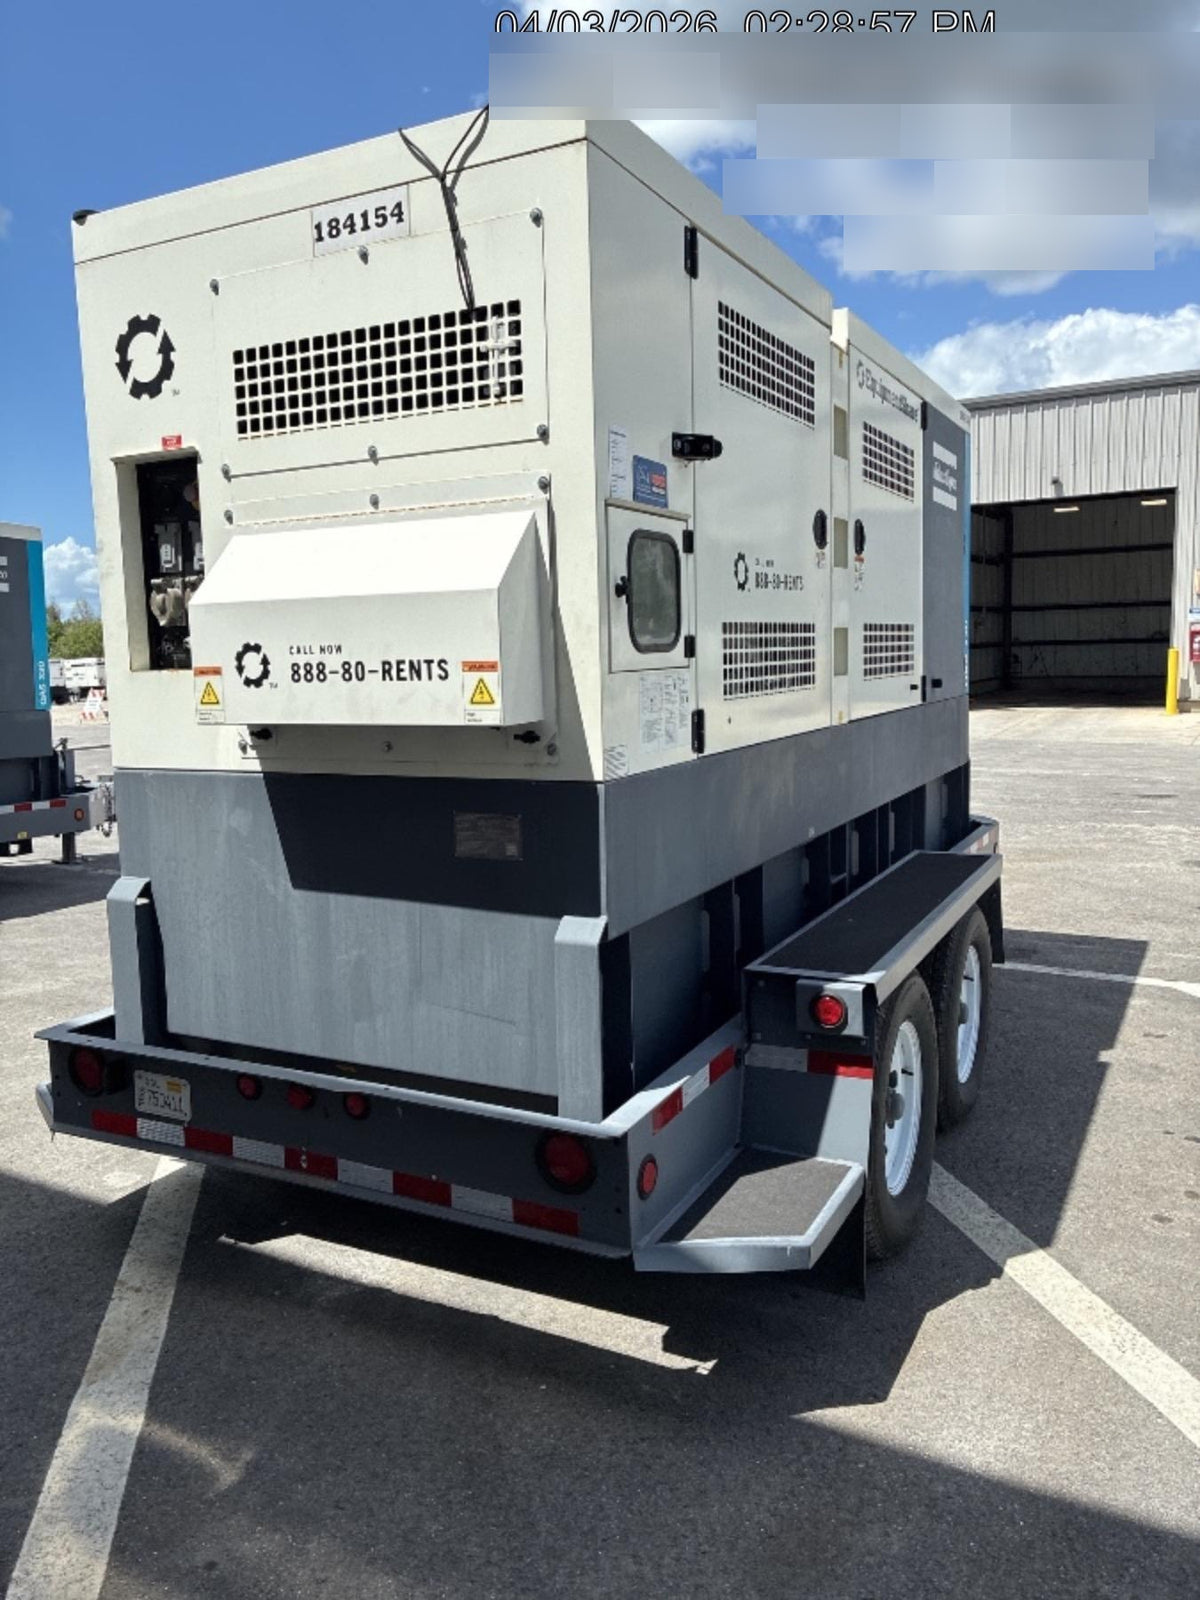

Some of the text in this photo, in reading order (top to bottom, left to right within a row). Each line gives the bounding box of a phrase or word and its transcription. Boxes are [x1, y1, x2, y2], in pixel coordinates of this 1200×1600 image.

[314, 200, 405, 243] 184154
[289, 644, 343, 655] CALL NOW
[290, 658, 450, 684] 888-80-RENTS
